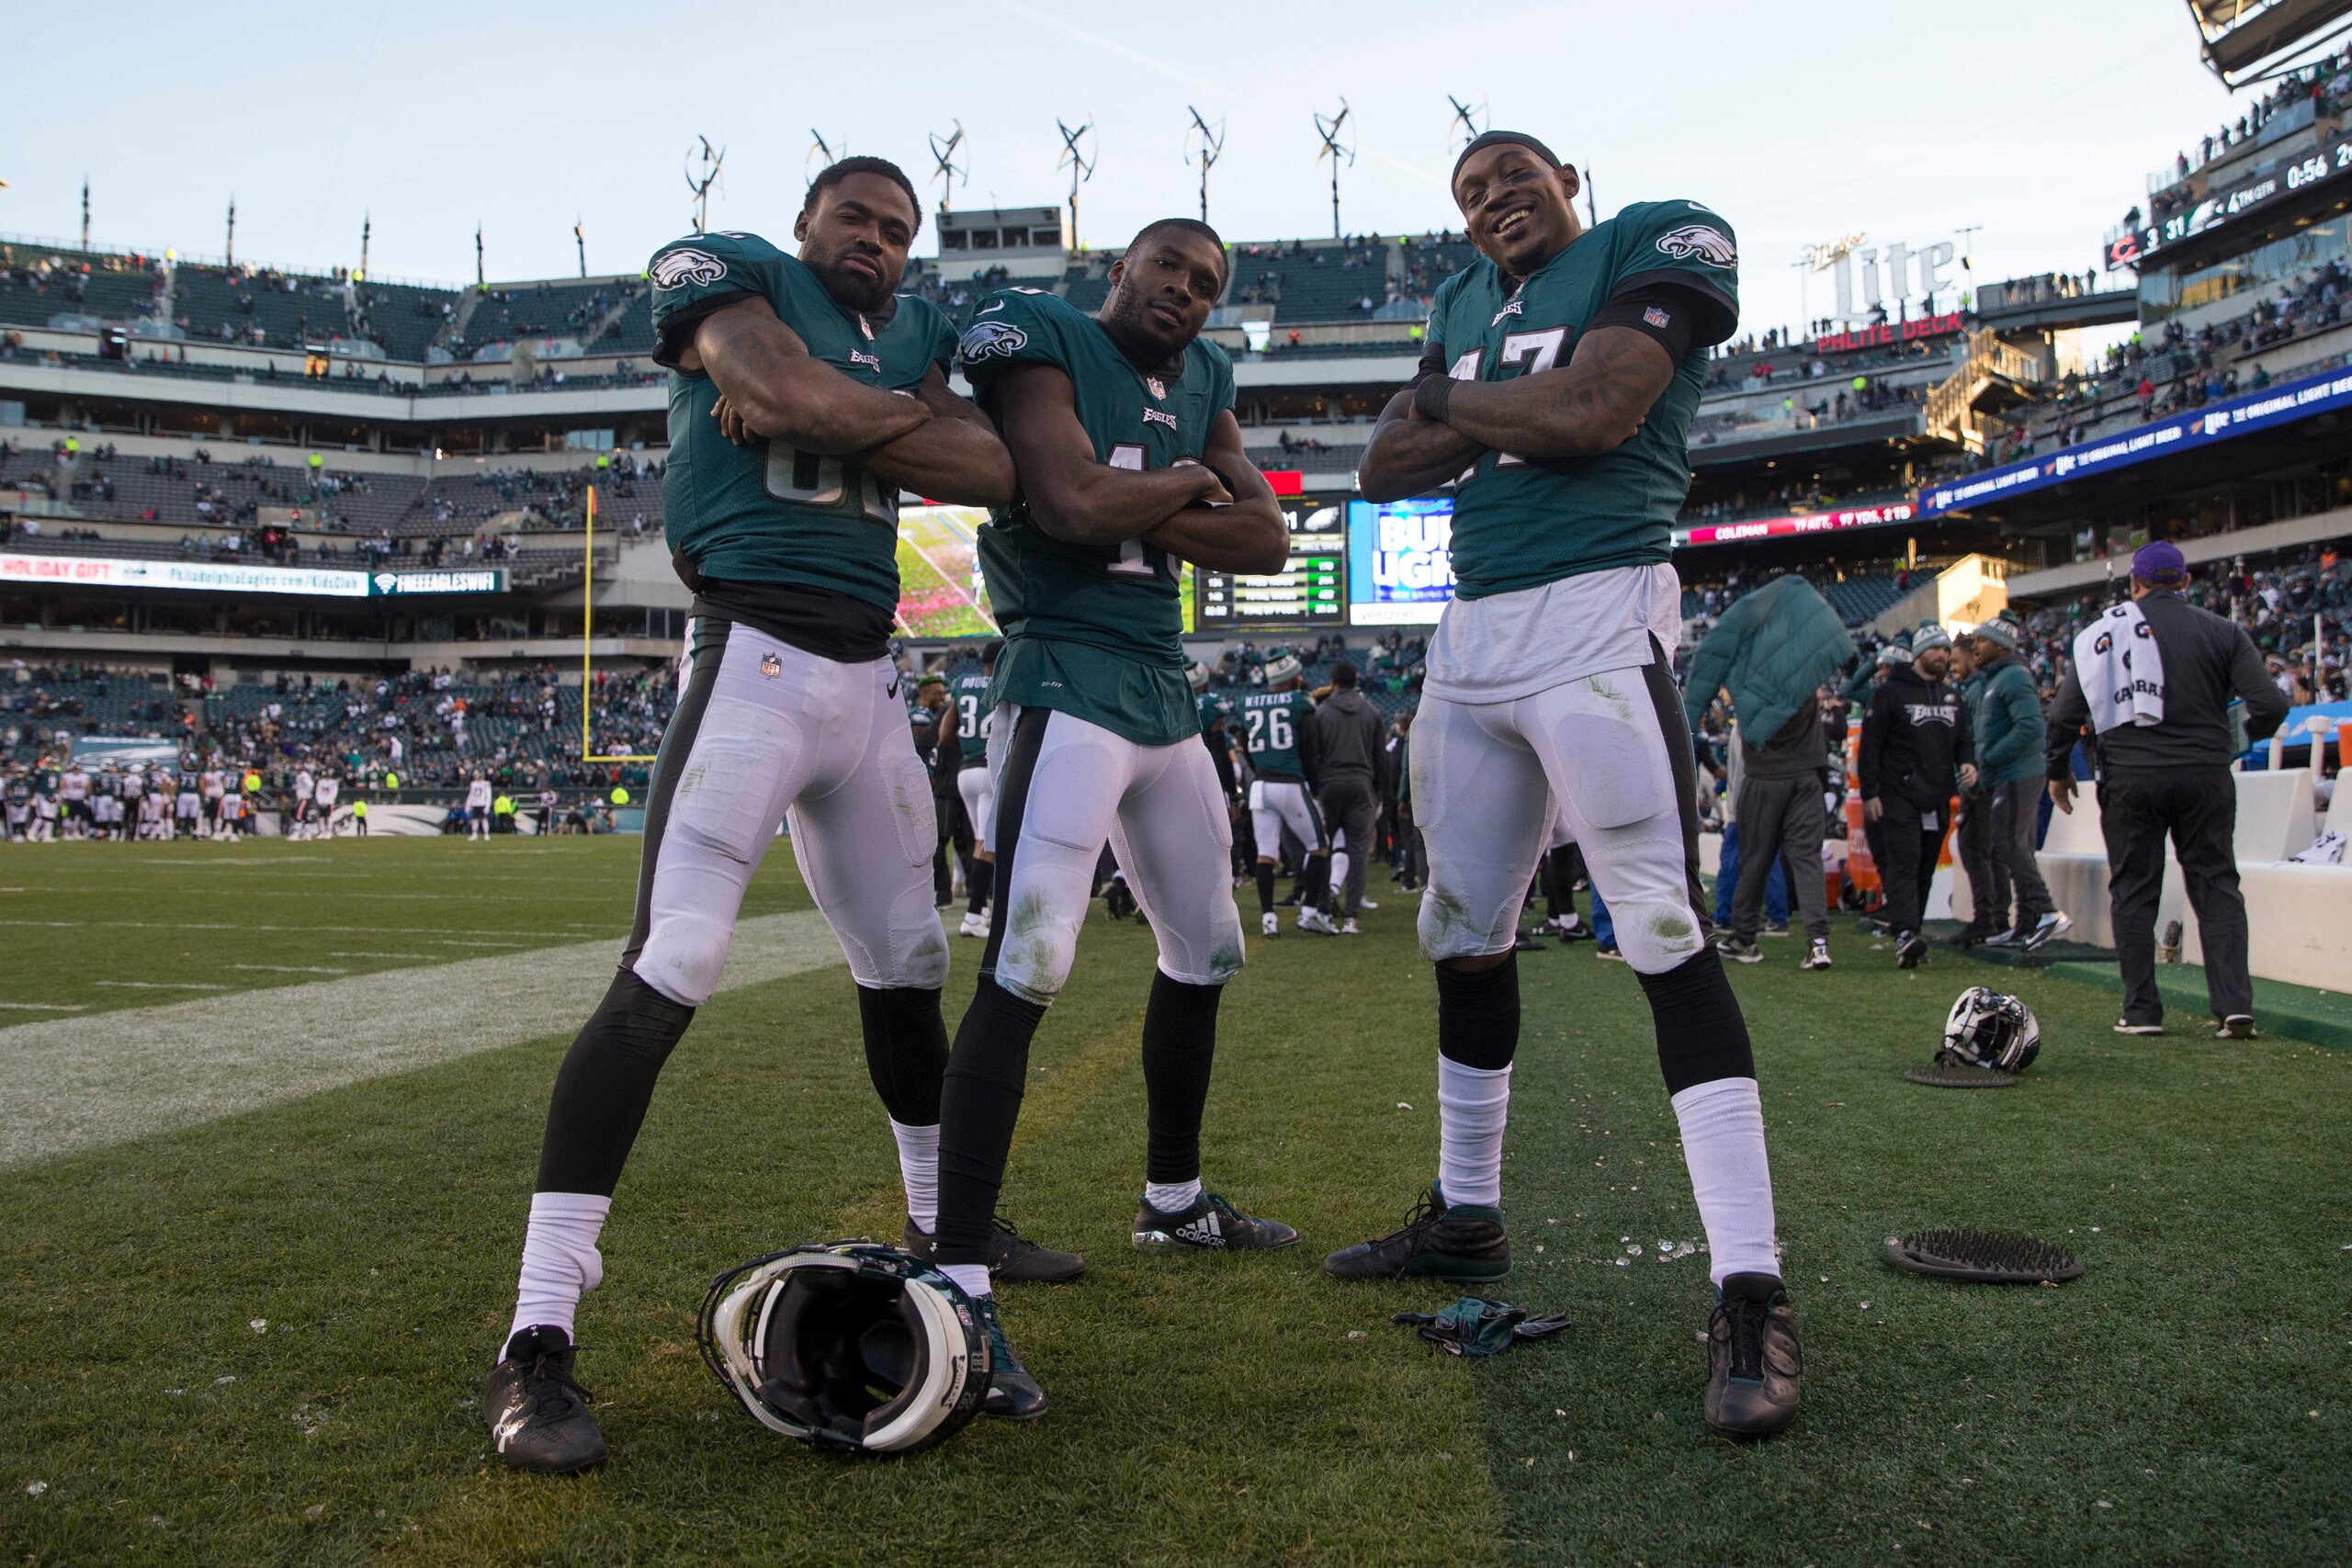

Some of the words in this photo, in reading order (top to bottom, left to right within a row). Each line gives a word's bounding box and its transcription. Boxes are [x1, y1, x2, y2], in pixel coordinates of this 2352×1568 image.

[2146, 228, 2159, 249] 3
[2165, 215, 2185, 241] 31
[2287, 153, 2328, 189] 0:56
[1830, 242, 1953, 321] Lite
[1817, 325, 1893, 355] PHLITE
[1902, 312, 1962, 340] DECK
[2246, 393, 2297, 419] ORIGINAL
[2298, 382, 2331, 405] LIGHT
[1142, 406, 1177, 431] EAGLES
[2088, 441, 2129, 462] ORIGINAL
[2130, 433, 2154, 452] LIGHT
[2155, 426, 2182, 445] BEER
[1715, 524, 1768, 540] COLEMAN
[1838, 511, 1855, 526] 97
[1883, 508, 1894, 522] 2
[1893, 505, 1911, 520] TD
[3, 559, 70, 577] HOLIDAY
[76, 563, 109, 580] GIFT
[1245, 693, 1293, 707] WATKINS
[1904, 704, 1958, 723] EAGLES
[1245, 707, 1293, 753] 26
[1176, 1227, 1226, 1247] adidas
